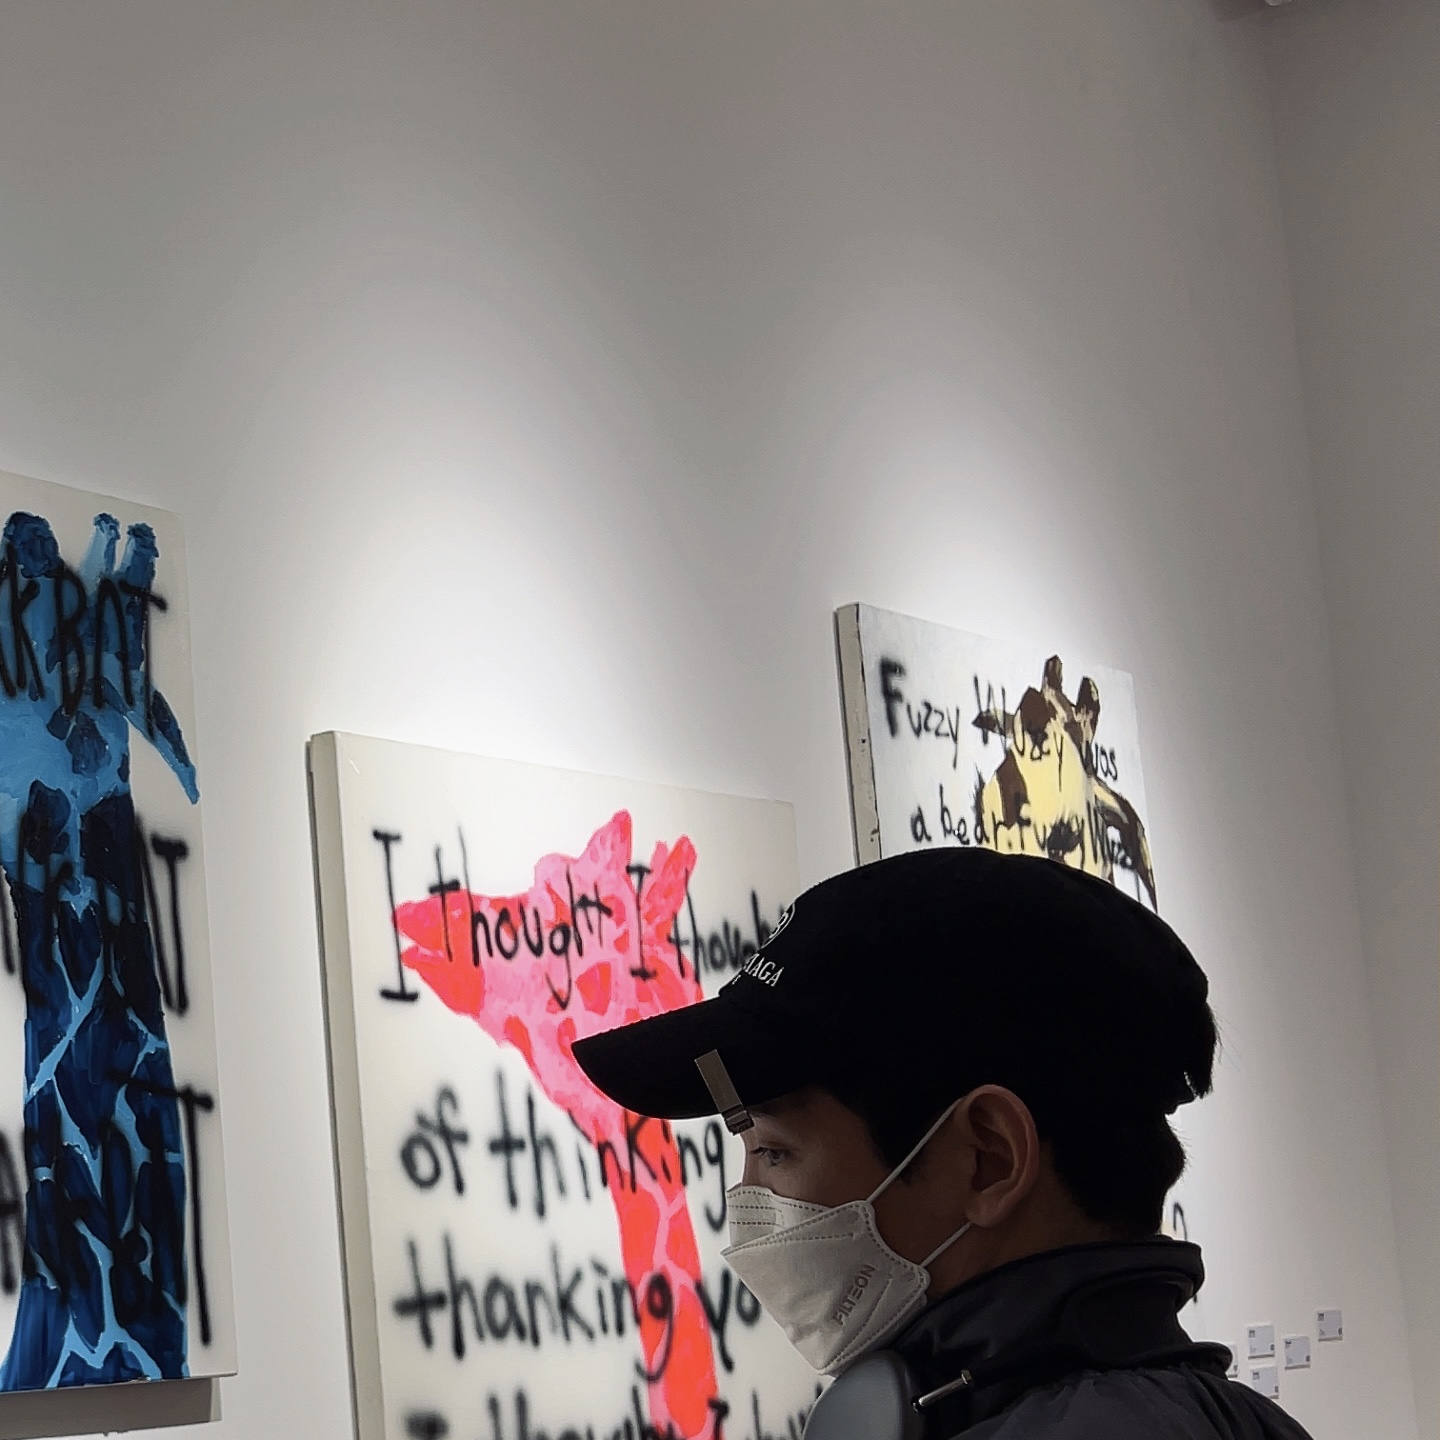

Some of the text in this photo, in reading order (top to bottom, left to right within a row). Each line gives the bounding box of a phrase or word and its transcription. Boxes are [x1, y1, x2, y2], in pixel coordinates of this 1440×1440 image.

[372, 828, 419, 1003] I
[428, 825, 613, 1008] thought
[625, 863, 657, 982] I
[400, 1084, 470, 1197] of
[392, 1230, 762, 1382] thanking yo
